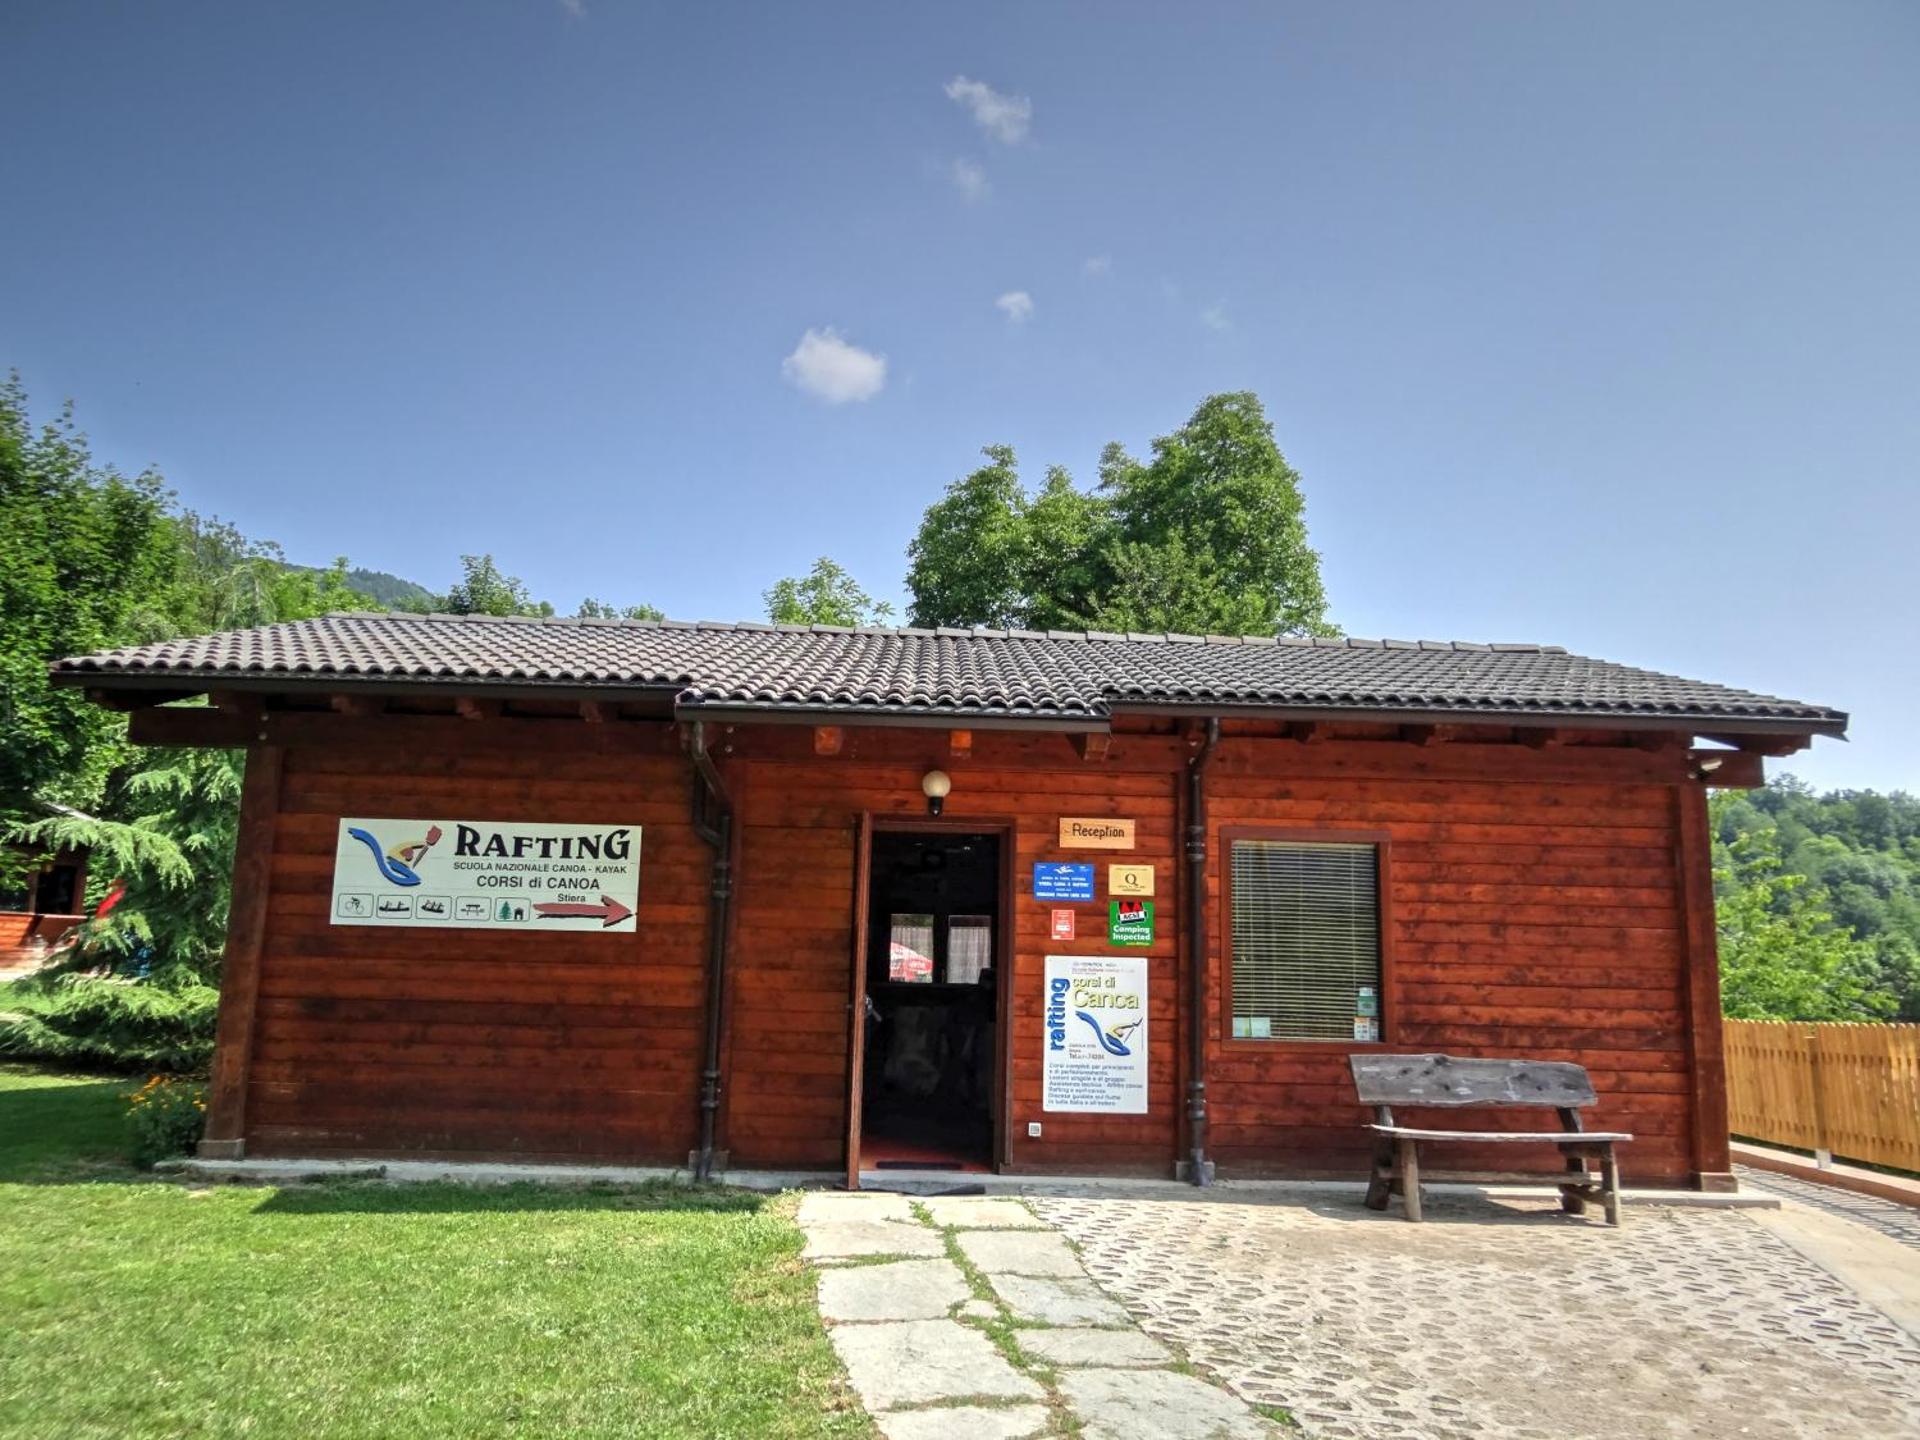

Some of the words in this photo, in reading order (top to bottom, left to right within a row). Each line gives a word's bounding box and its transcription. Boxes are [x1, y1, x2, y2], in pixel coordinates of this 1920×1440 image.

[1072, 822, 1125, 840] Reception
[454, 823, 631, 860] RAFTING
[453, 861, 493, 871] SCUOLA
[494, 863, 549, 873] NAZIONALE
[552, 864, 586, 873] CANOA
[595, 865, 627, 874] KAYAK
[477, 875, 523, 888] CORSI
[529, 876, 541, 889] di
[547, 877, 600, 890] CANOA
[1125, 873, 1138, 887] Q
[1112, 932, 1150, 941] Inspected
[1113, 925, 1150, 934] Camping
[1073, 976, 1101, 988] corsi
[1105, 976, 1116, 988] di
[1074, 989, 1139, 1009] Canoa
[1047, 977, 1070, 1051] rafting
